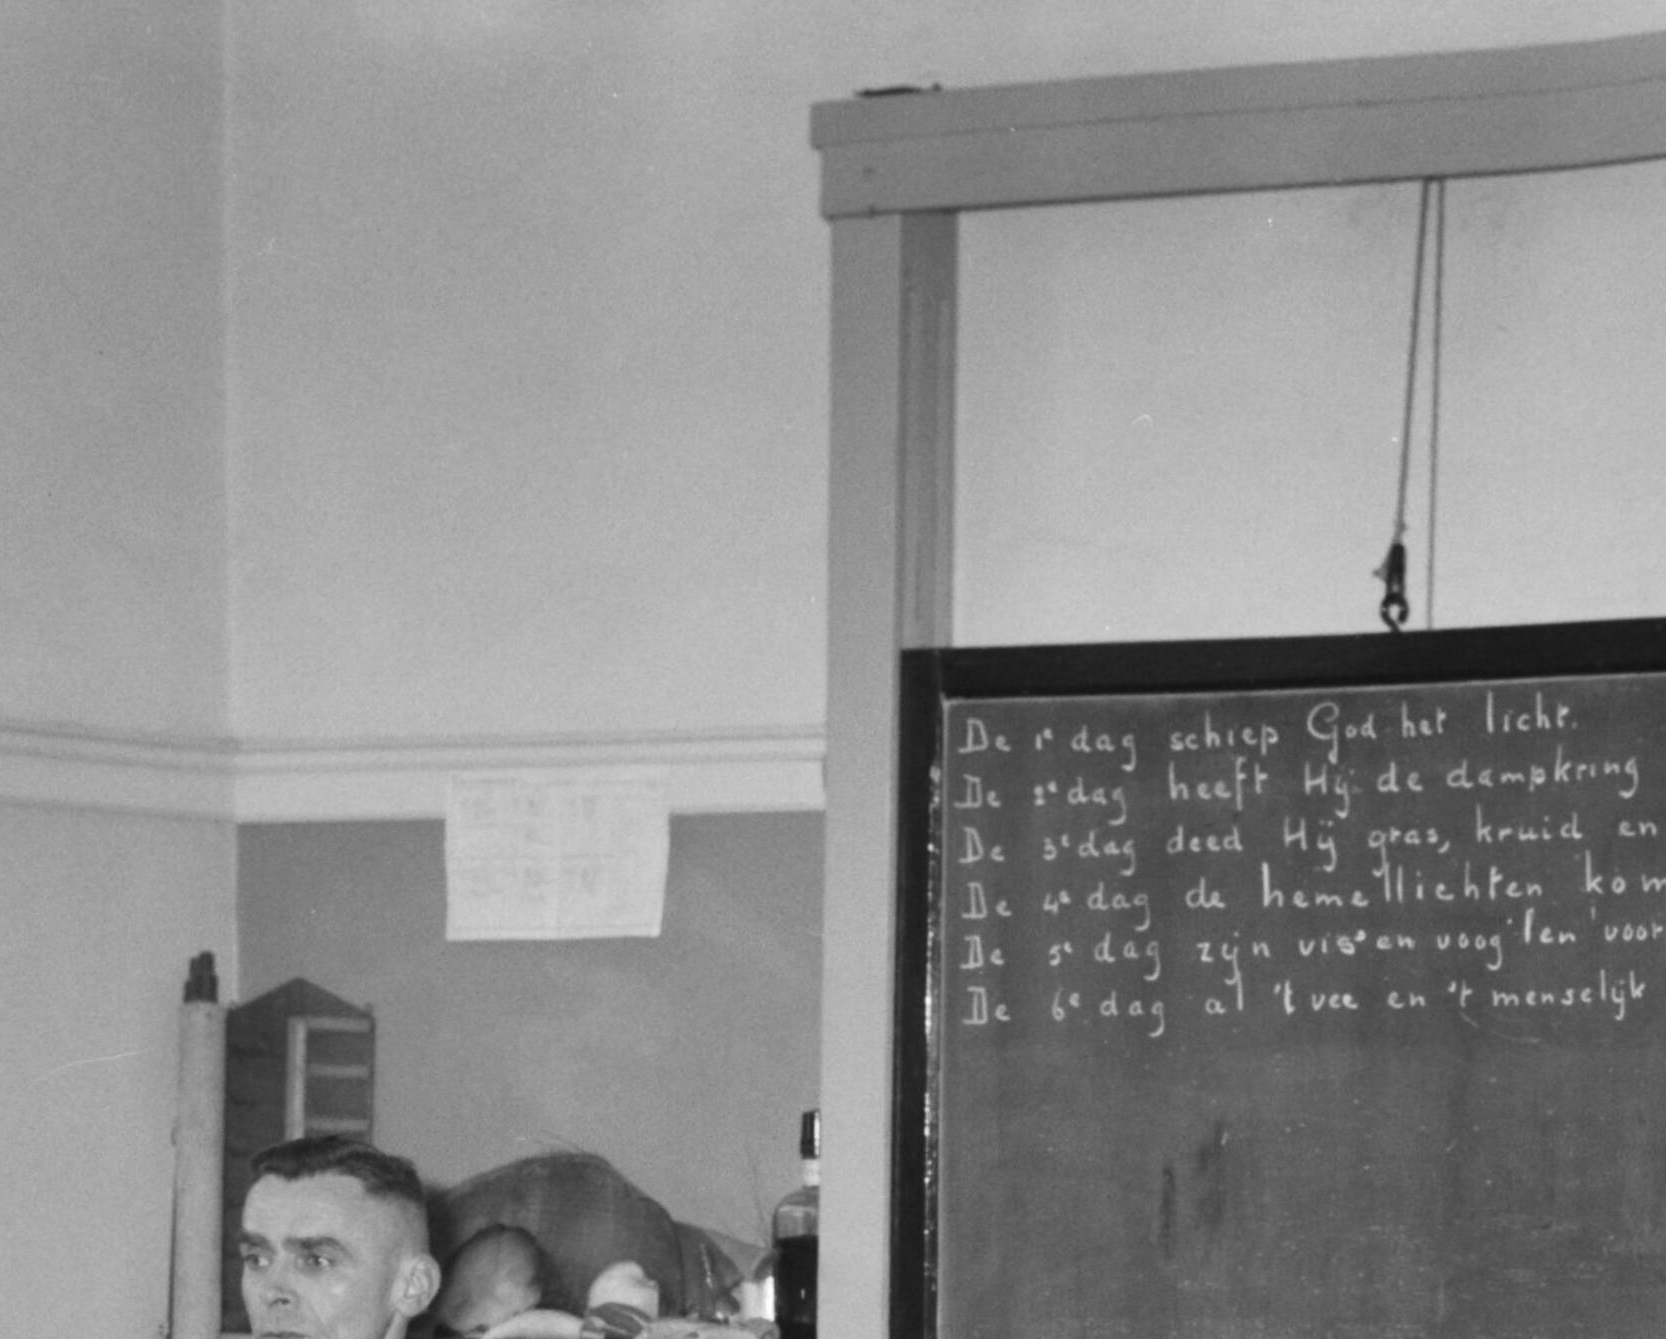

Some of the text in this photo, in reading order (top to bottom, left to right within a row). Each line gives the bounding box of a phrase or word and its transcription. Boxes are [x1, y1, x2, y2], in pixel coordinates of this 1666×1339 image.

[958, 717, 1011, 754] De
[1071, 725, 1137, 771] dag
[1170, 710, 1279, 756] schiep
[1306, 702, 1377, 765] God
[1401, 701, 1446, 738] het
[1486, 690, 1579, 734] licht.
[954, 774, 1001, 808] De
[1067, 776, 1127, 825] dag
[1168, 756, 1268, 811] heeft
[1377, 760, 1423, 793] de
[1445, 744, 1639, 799] dampkring
[958, 826, 1004, 863] De
[1078, 828, 1136, 877] dag
[1166, 824, 1243, 854] deed
[1367, 827, 1450, 878] gras,
[1475, 802, 1583, 844] kruid
[1618, 819, 1658, 838] en
[961, 881, 1012, 919] De
[1086, 881, 1151, 931] dag
[1185, 877, 1226, 908] de
[959, 935, 1005, 970] De
[1094, 931, 1161, 982] dag
[1376, 934, 1416, 951] en
[962, 986, 1011, 1025] De
[1100, 990, 1165, 1038] dag
[1204, 971, 1244, 1013] al
[1274, 979, 1295, 1015] 't
[1311, 993, 1358, 1012] vee
[1388, 990, 1426, 1009] en
[1492, 969, 1646, 1021] menselijk
